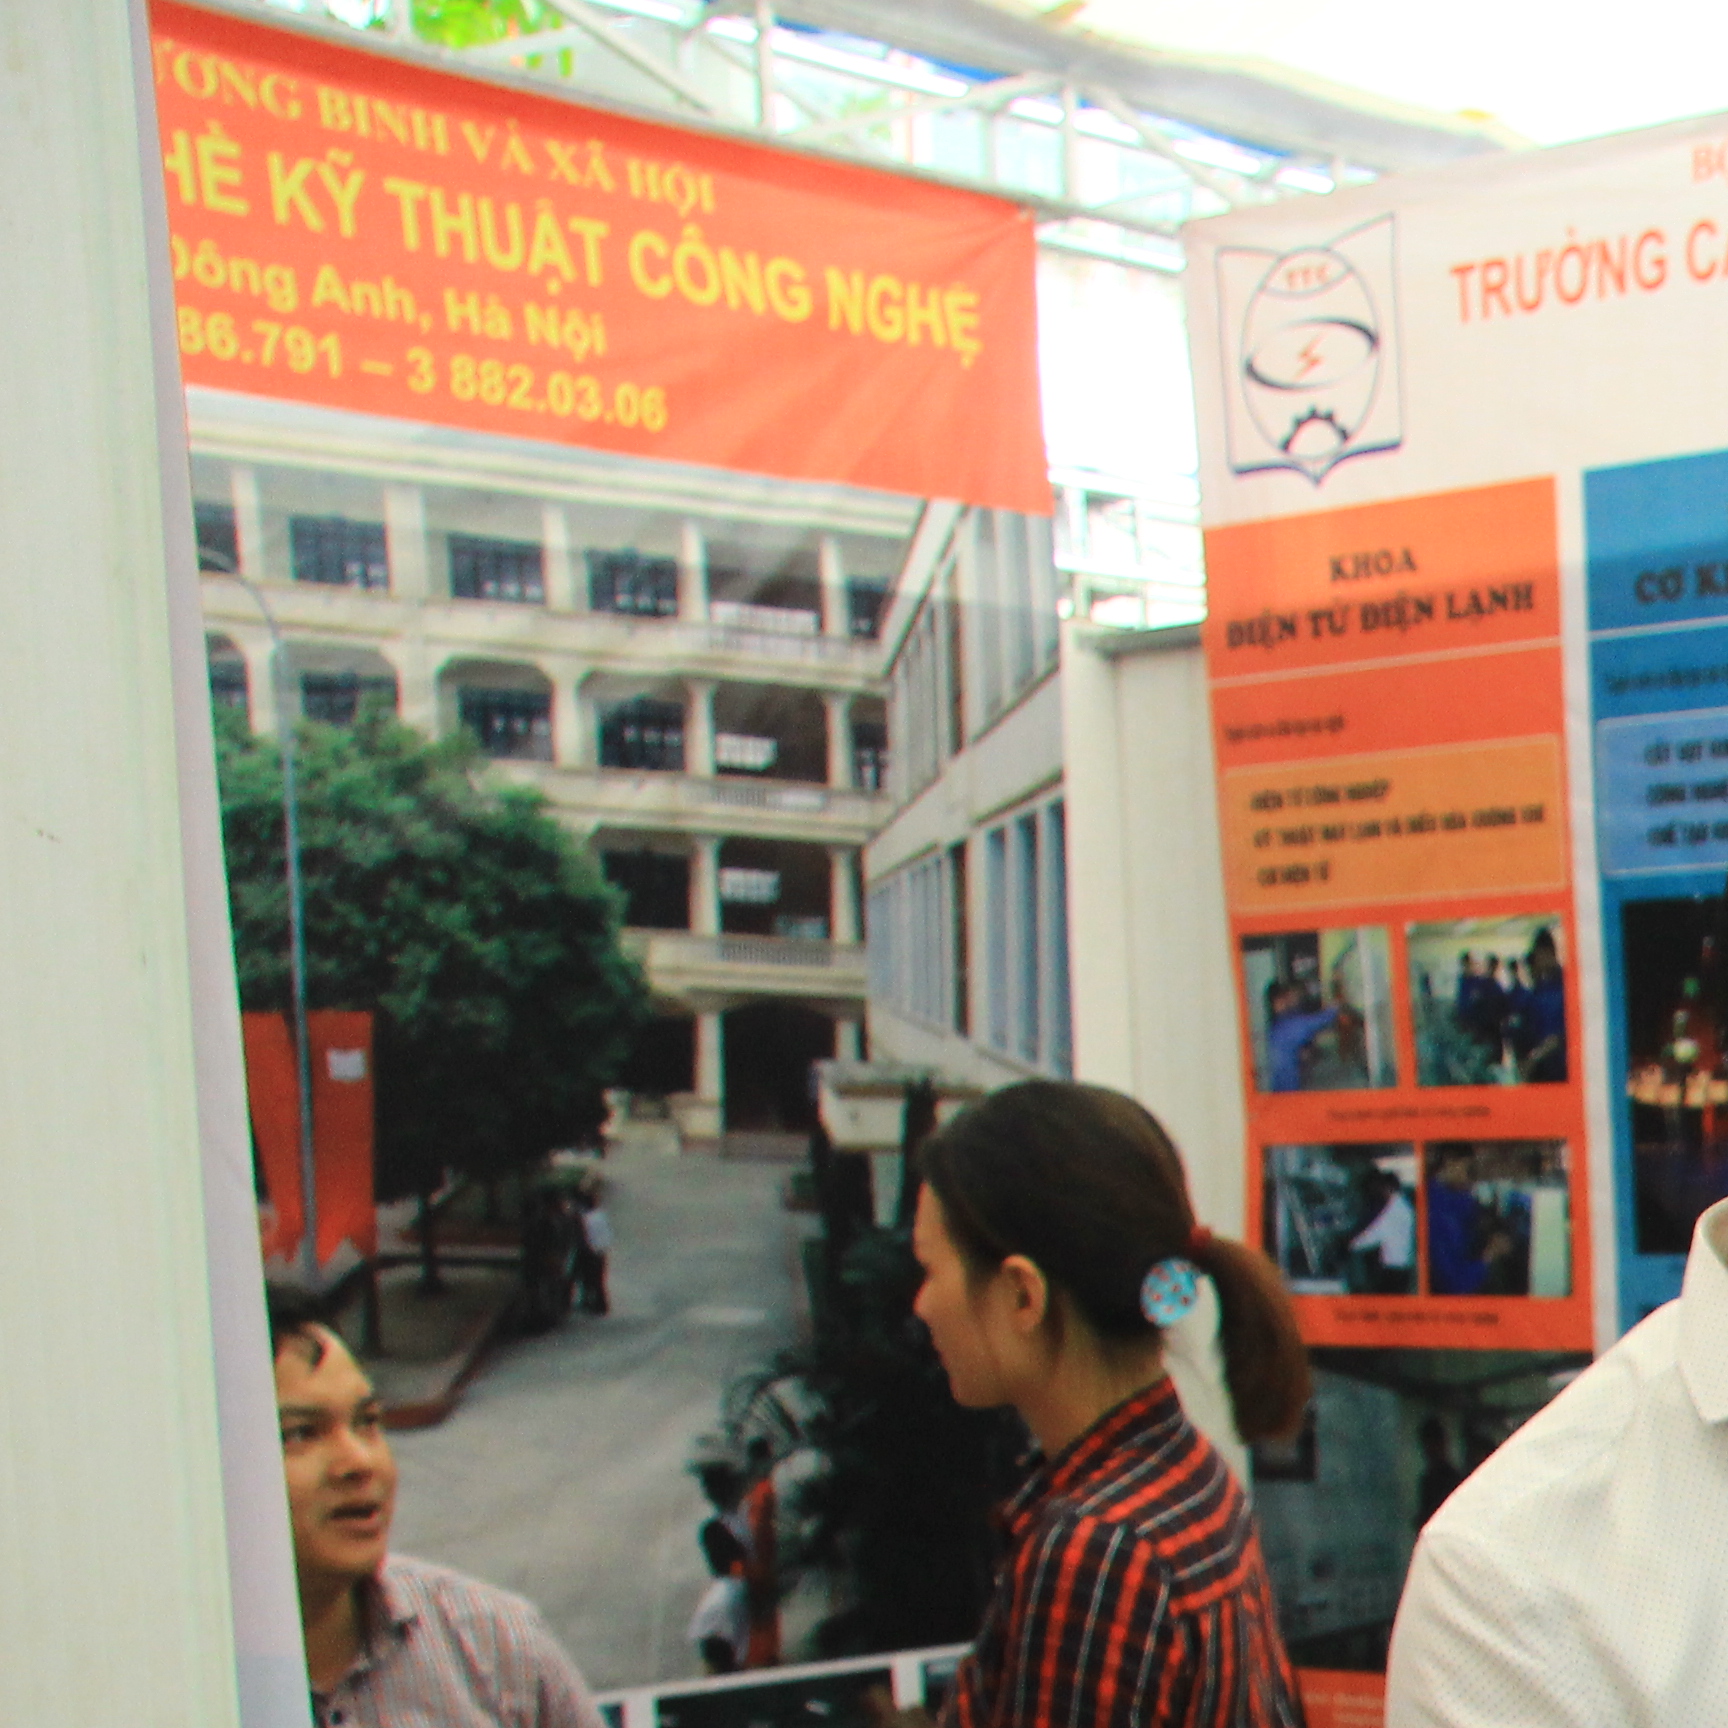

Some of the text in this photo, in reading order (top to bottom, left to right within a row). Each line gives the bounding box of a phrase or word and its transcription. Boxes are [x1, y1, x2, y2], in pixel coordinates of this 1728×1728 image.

[460, 117, 535, 175] VÀ
[545, 139, 616, 193] XÃ
[267, 148, 367, 239] KỸ
[382, 176, 611, 297] THUẬT
[628, 222, 813, 324] CÔNG
[824, 265, 985, 371] NGHỆ
[1450, 226, 1668, 325] TRƯỜNG
[311, 264, 434, 336] Anh,
[443, 287, 514, 341] Hà
[522, 300, 608, 364] Nội
[405, 347, 438, 395] 3
[448, 354, 669, 434] 882.03.06
[1329, 548, 1418, 582] KHOA
[1446, 581, 1535, 623] LẠNH
